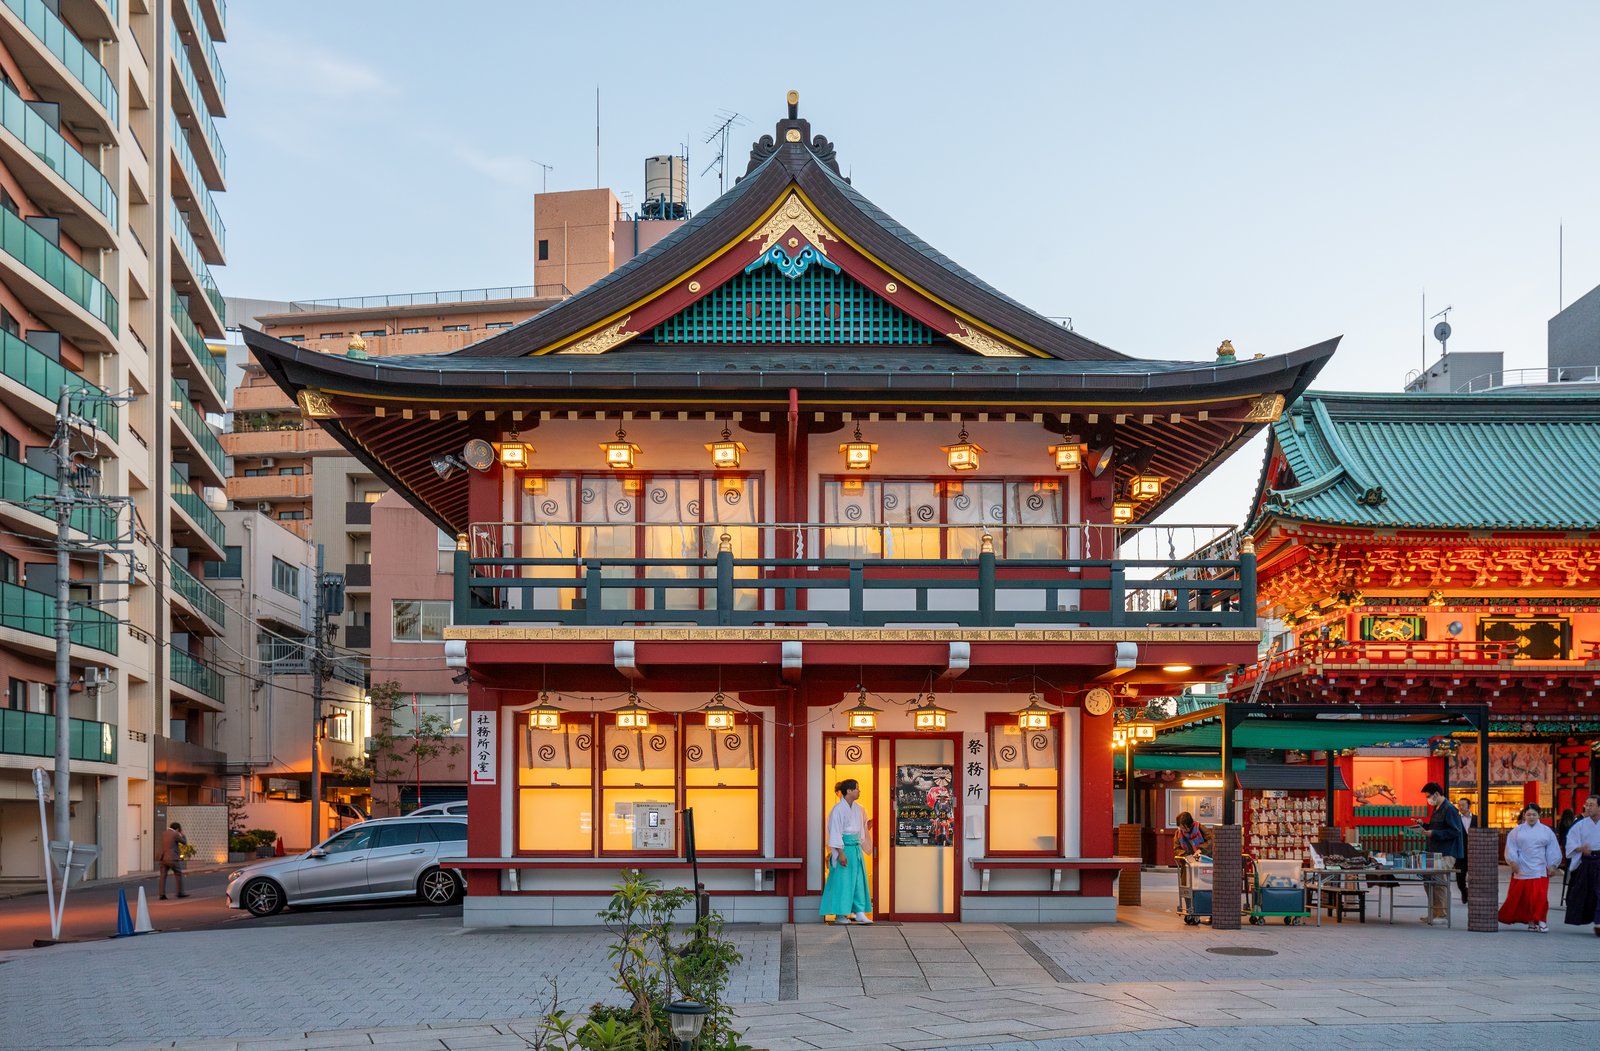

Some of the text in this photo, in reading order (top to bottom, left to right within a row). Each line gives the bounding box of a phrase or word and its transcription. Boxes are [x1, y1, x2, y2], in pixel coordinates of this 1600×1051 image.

[476, 714, 491, 773] 社務所分室
[967, 738, 984, 799] 祭務所
